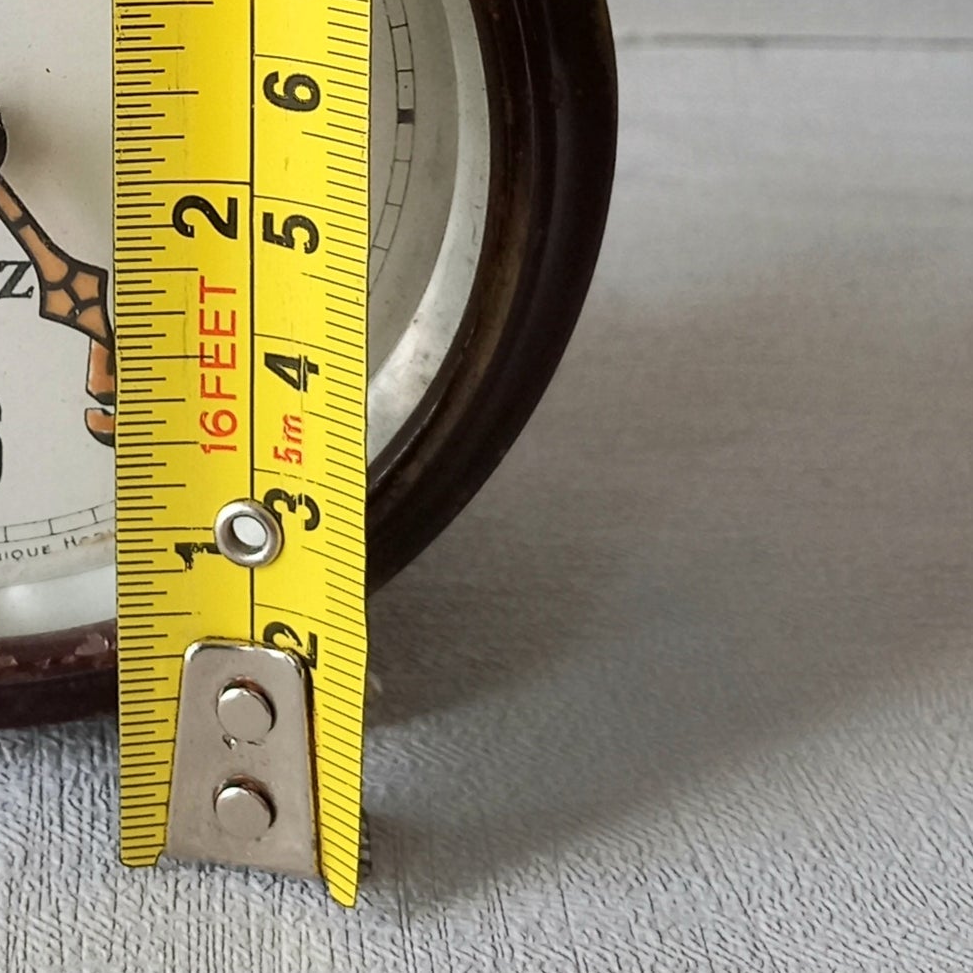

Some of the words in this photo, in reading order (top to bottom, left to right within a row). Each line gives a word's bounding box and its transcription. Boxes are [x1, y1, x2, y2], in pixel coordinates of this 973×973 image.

[263, 71, 321, 112] 6
[172, 195, 238, 239] 2
[262, 212, 320, 254] 5
[264, 352, 320, 393] 4
[263, 488, 321, 531] 3
[263, 621, 318, 670] 2
